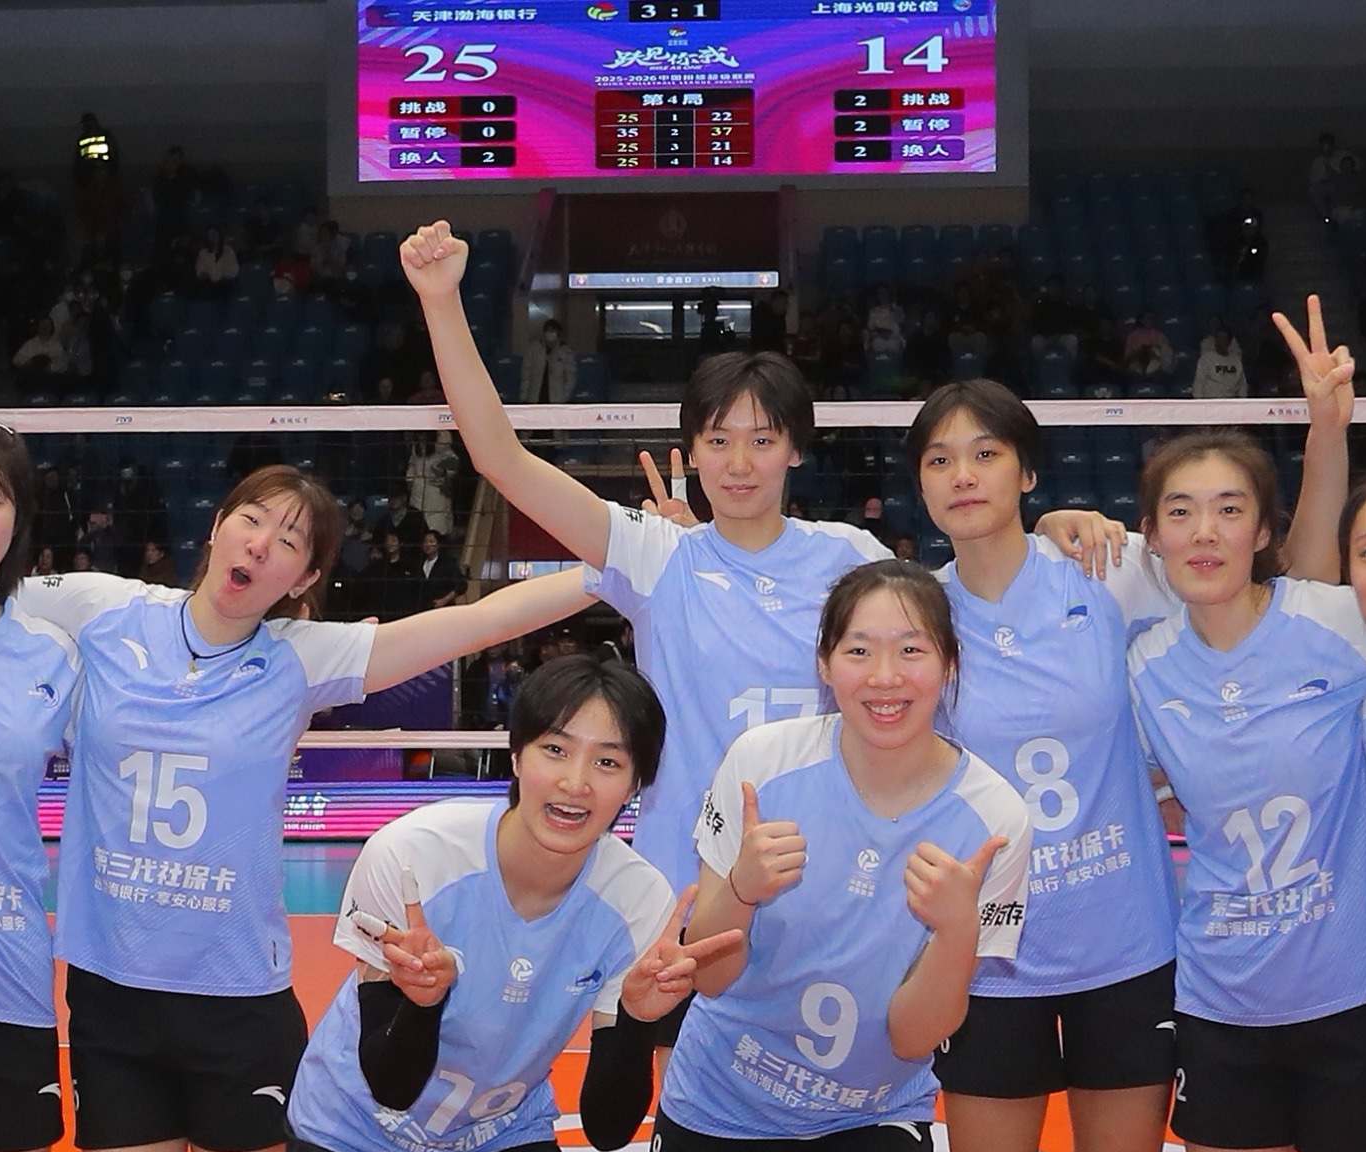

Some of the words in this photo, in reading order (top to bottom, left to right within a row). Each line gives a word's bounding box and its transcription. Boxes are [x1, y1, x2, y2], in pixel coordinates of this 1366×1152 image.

[413, 9, 537, 22] 天津渤海银行
[641, 6, 656, 18] 3
[694, 4, 706, 17] 1
[857, 35, 949, 74] 14
[404, 44, 498, 82] 25
[854, 95, 867, 106] 2
[902, 92, 950, 106] 挑战
[399, 101, 447, 114] 挑战
[482, 101, 495, 113] 0
[617, 114, 639, 124] 25
[672, 114, 678, 122] 1
[711, 112, 733, 122] 22
[854, 120, 867, 132] 2
[902, 118, 950, 131] 暂停
[399, 126, 446, 139] 暂停
[482, 126, 495, 138] 0
[617, 128, 639, 138] 35
[670, 128, 679, 137] 2
[711, 127, 733, 137] 37
[617, 143, 639, 153] 25
[670, 143, 679, 151] 3
[711, 141, 731, 151] 21
[854, 146, 867, 157] 2
[901, 144, 950, 157] 换人
[399, 152, 446, 165] 换人
[482, 152, 495, 163] 2
[617, 157, 639, 167] 25
[670, 158, 679, 166] 4
[713, 156, 733, 166] 14
[1015, 737, 1080, 832] 8
[119, 750, 209, 849] 15
[1028, 824, 1125, 874] 代社保卡
[1223, 795, 1320, 895] 12
[93, 847, 236, 893] 第三代社保卡
[1029, 852, 1132, 895] 银行·享安心服务
[795, 982, 859, 1070] 9
